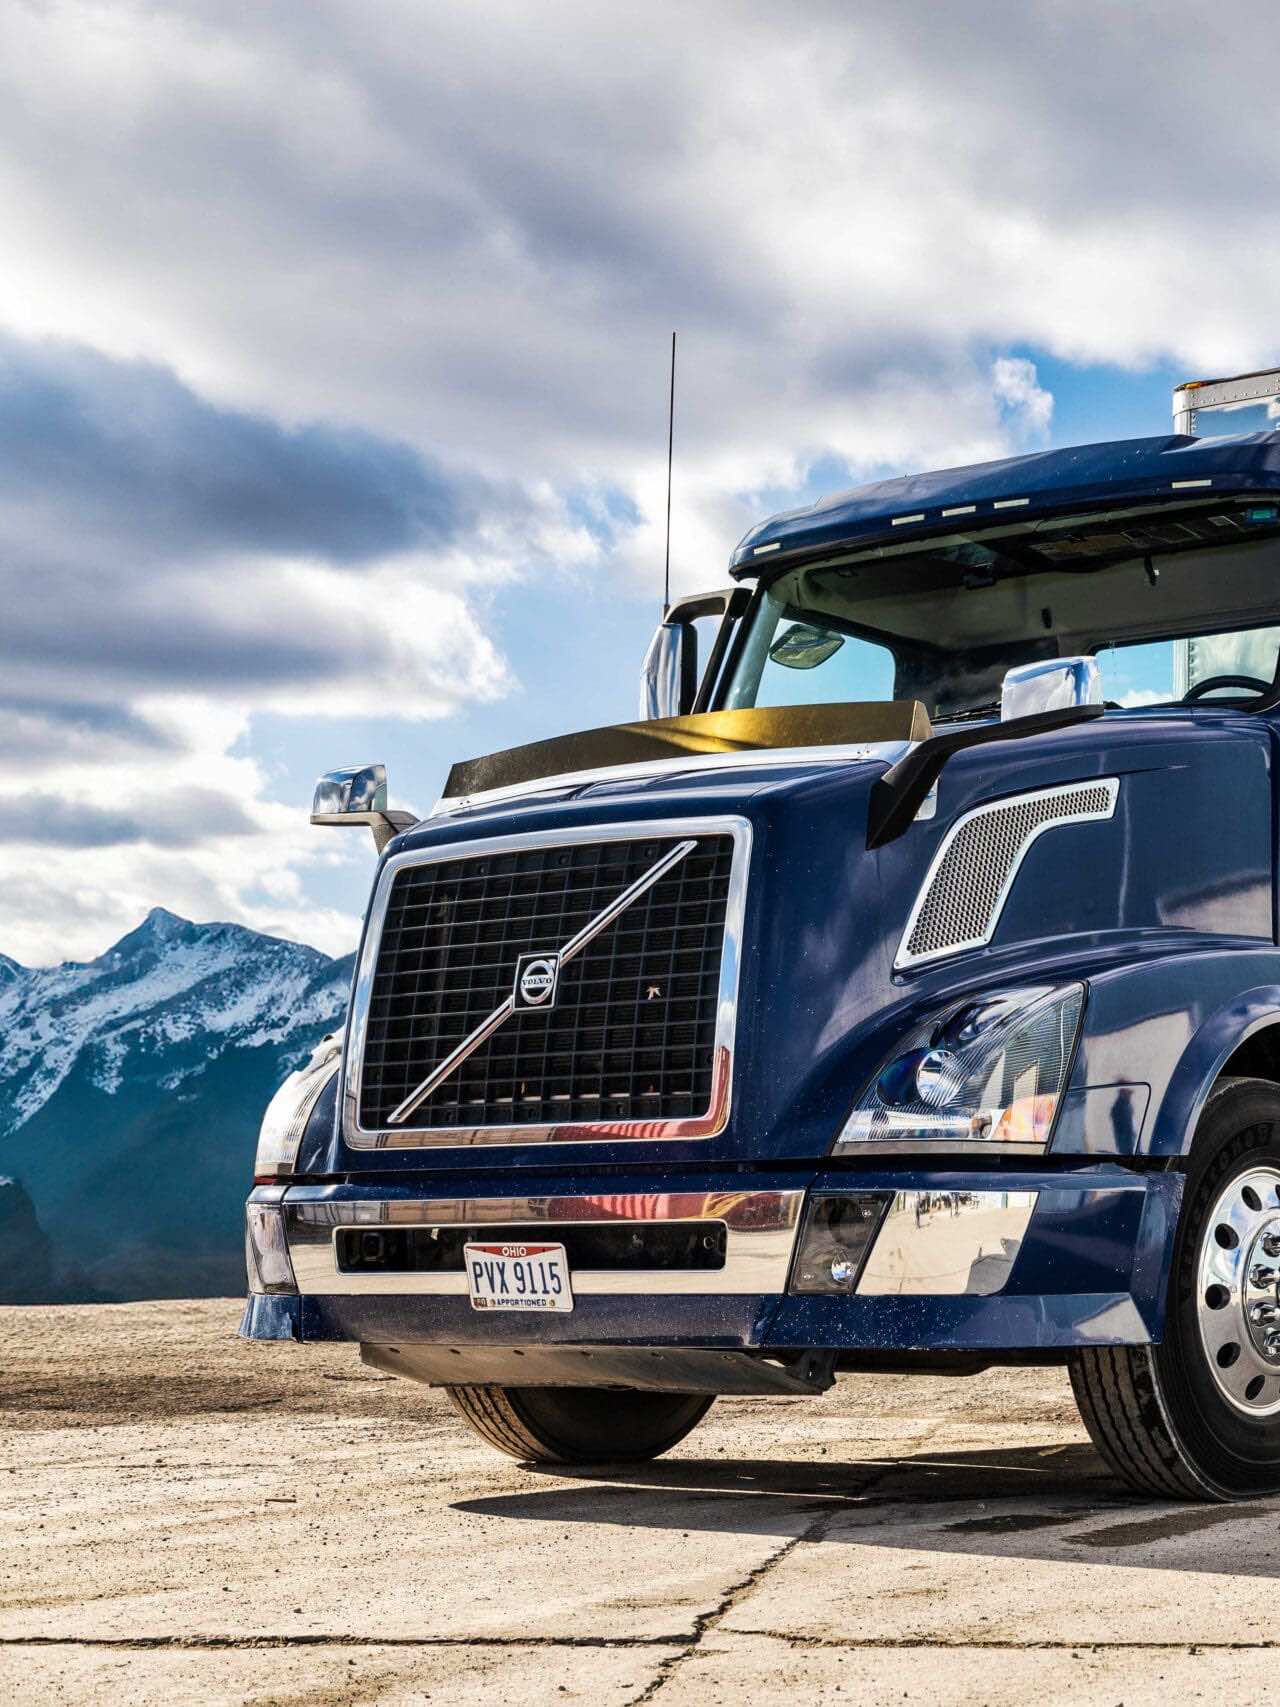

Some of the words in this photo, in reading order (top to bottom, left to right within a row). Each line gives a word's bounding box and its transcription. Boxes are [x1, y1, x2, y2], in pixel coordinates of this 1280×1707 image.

[522, 977, 552, 985] VOLVO
[502, 1247, 526, 1256] OHIO
[472, 1261, 509, 1293] PVX
[513, 1261, 562, 1295] 9115
